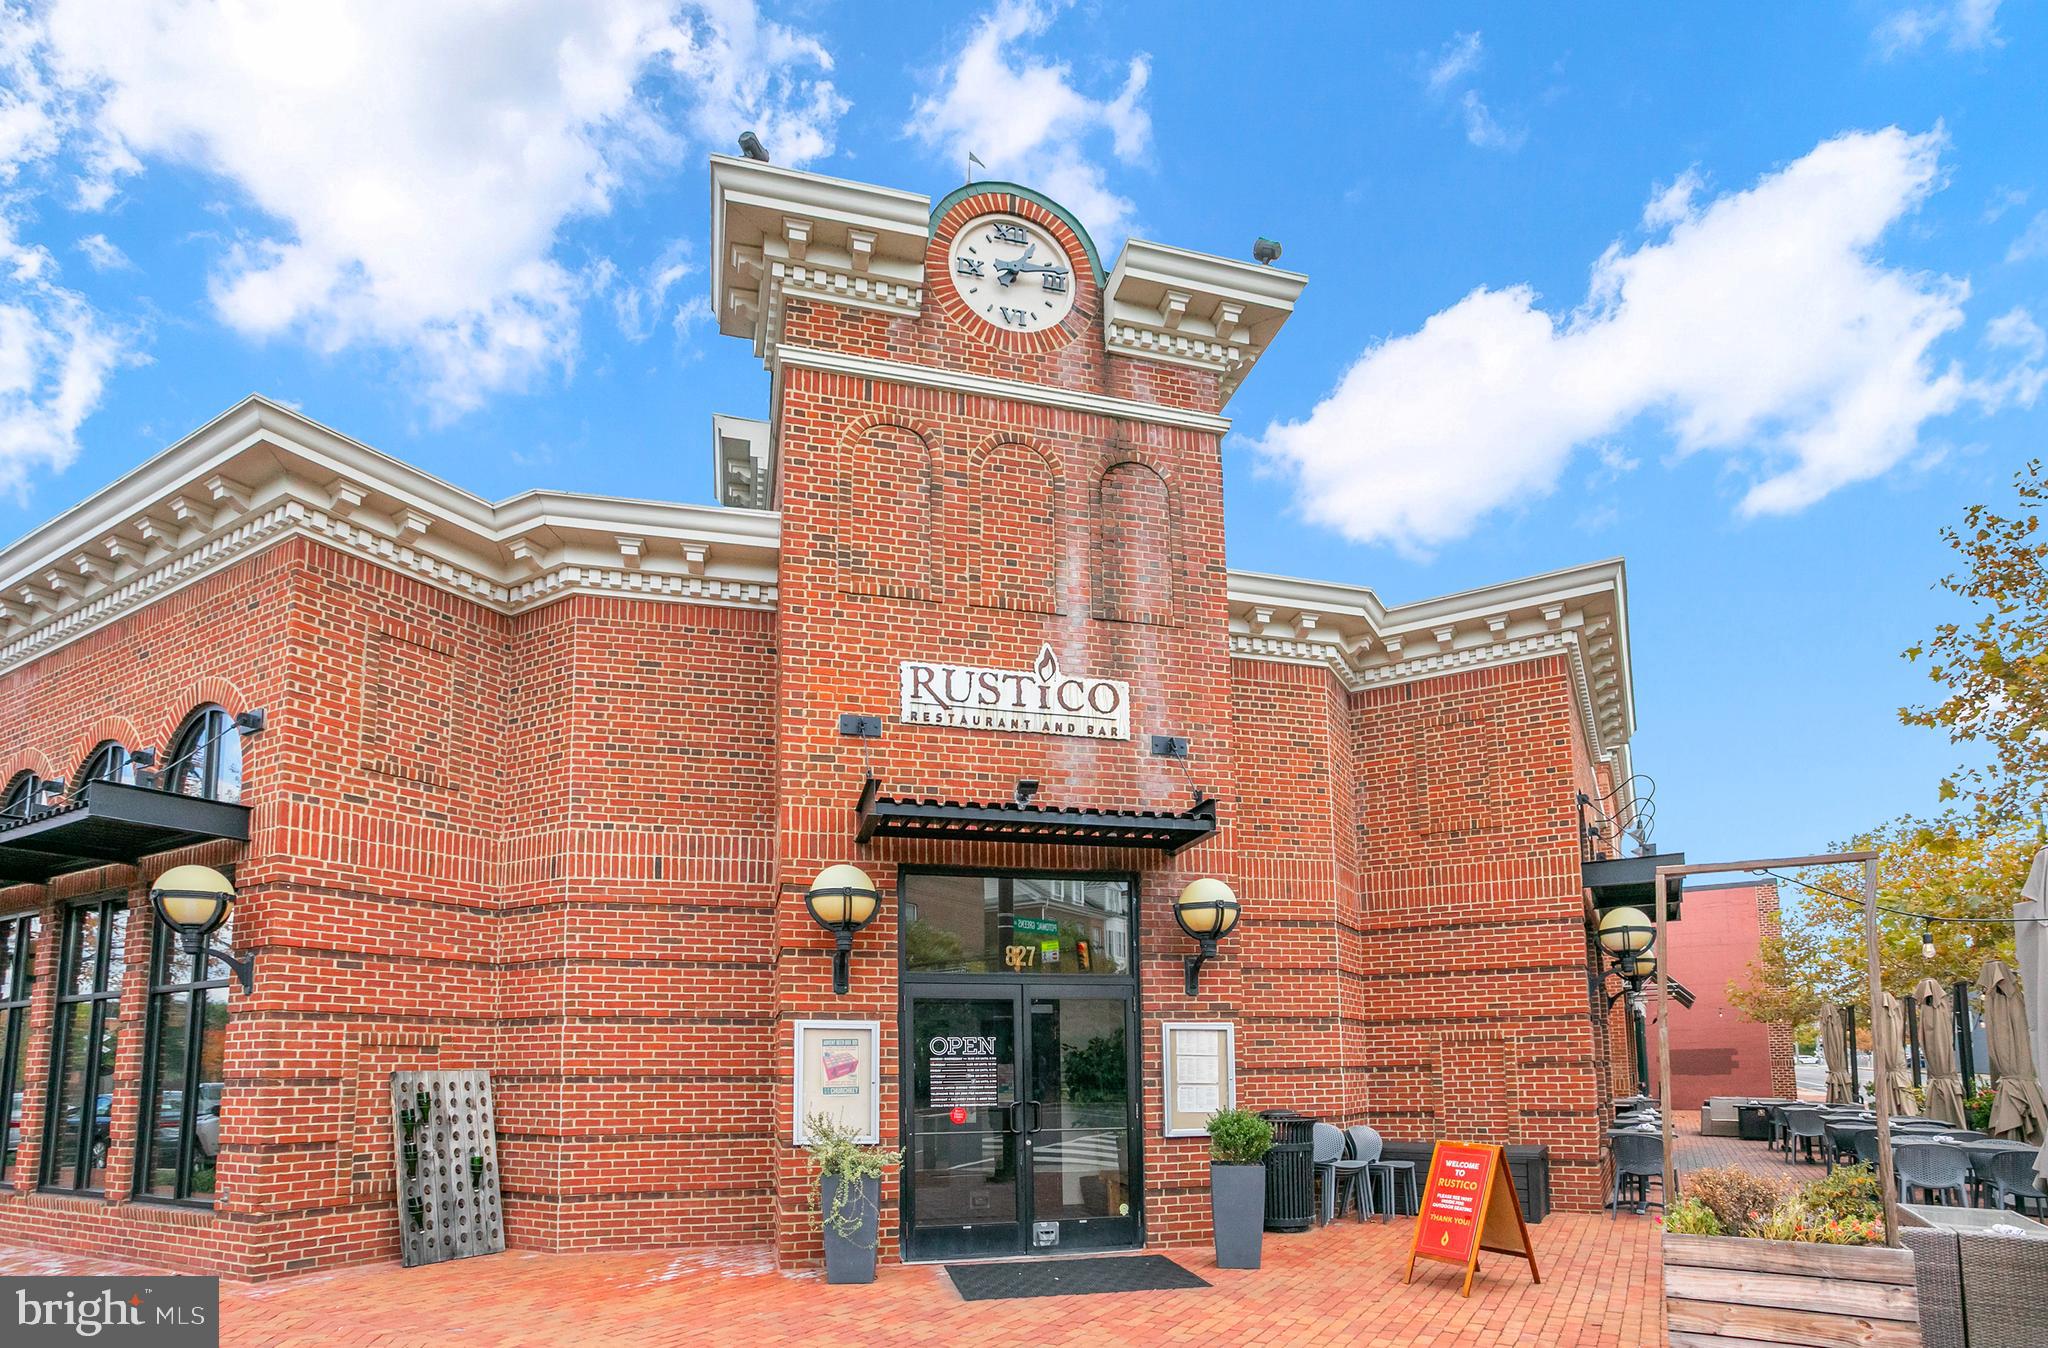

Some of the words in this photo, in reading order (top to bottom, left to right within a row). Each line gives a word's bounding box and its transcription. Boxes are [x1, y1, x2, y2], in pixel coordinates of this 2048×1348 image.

[910, 711, 1031, 731] RESTAURANT
[1042, 721, 1076, 734] AND
[1087, 725, 1119, 737] BAR
[1005, 945, 1036, 966] 827
[929, 1036, 997, 1056] OPEN
[1445, 1160, 1480, 1169] WELCOME
[1455, 1169, 1465, 1177] TO
[1438, 1178, 1478, 1190] RUSTICO
[1430, 1214, 1453, 1223] THANK
